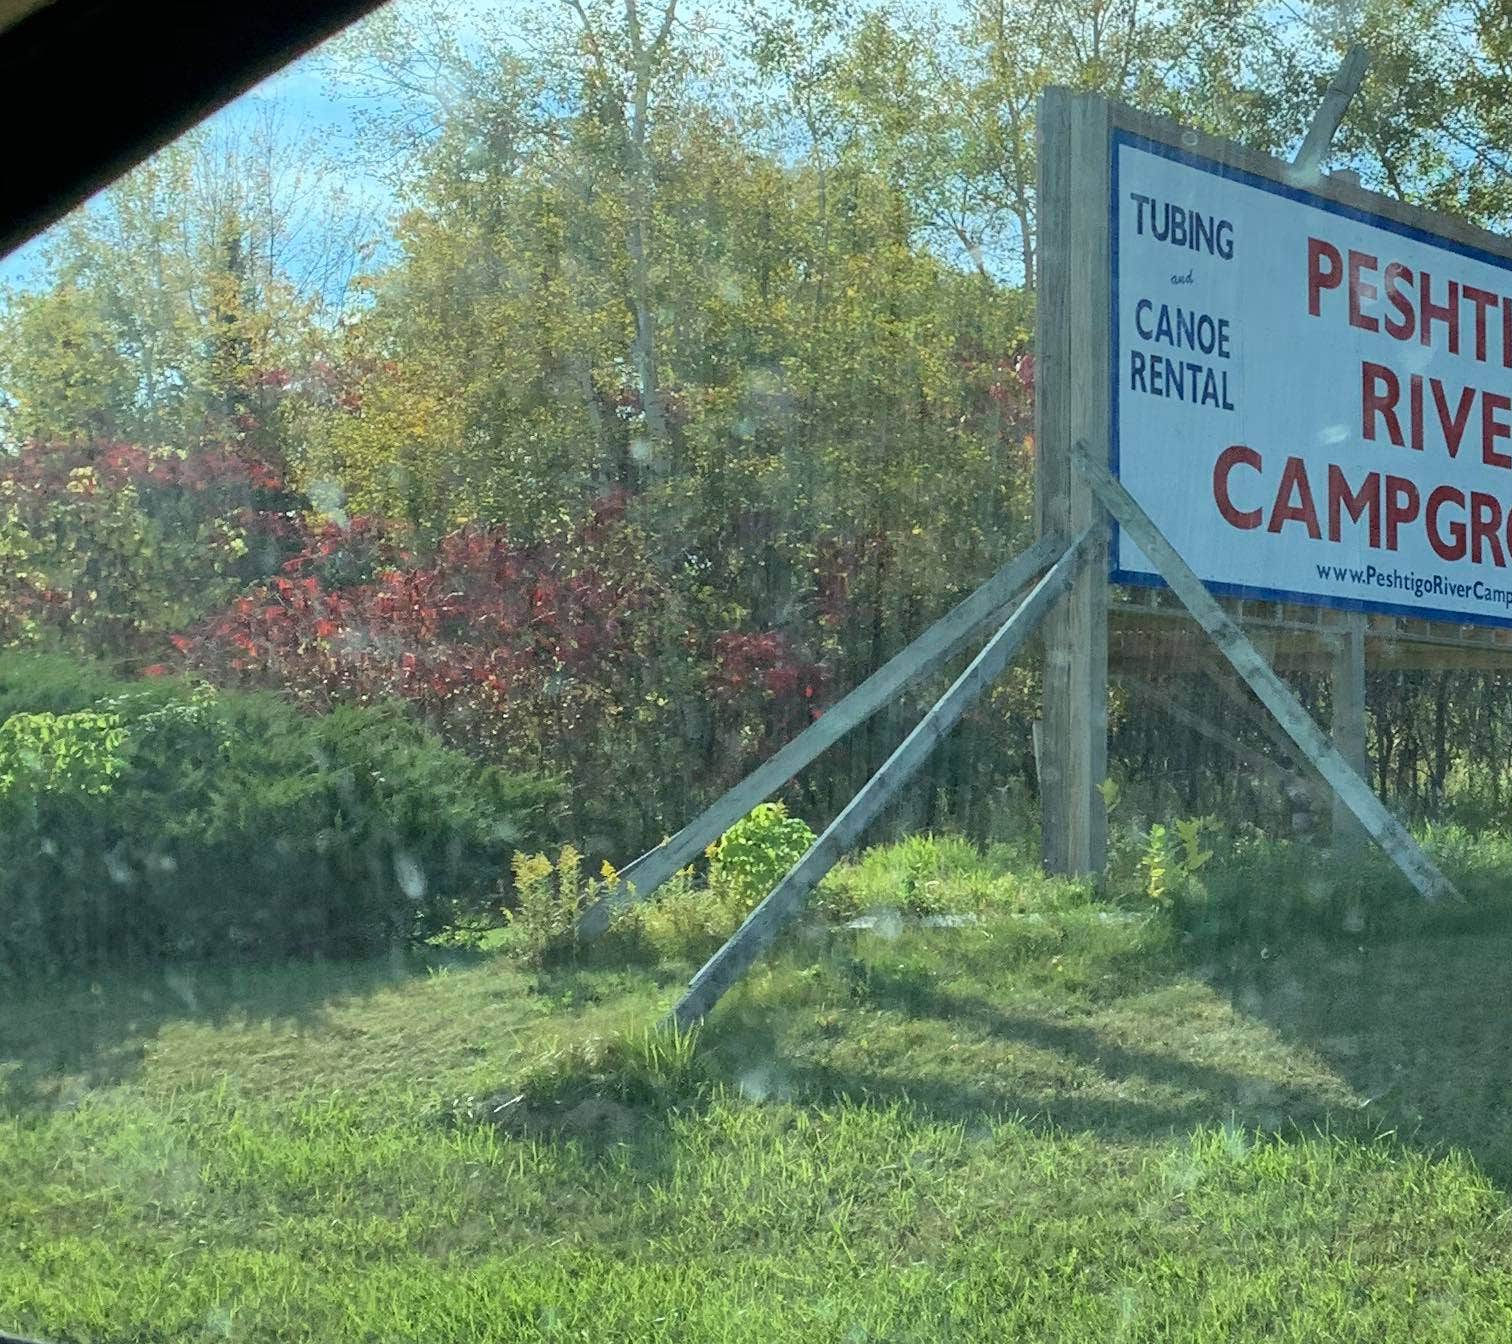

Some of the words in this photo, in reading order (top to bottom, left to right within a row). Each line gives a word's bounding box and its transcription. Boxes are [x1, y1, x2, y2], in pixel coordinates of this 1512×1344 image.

[1130, 192, 1234, 260] TUBING
[1171, 269, 1194, 285] and
[1135, 298, 1231, 359] CANOE
[1130, 349, 1235, 411] RENTAL
